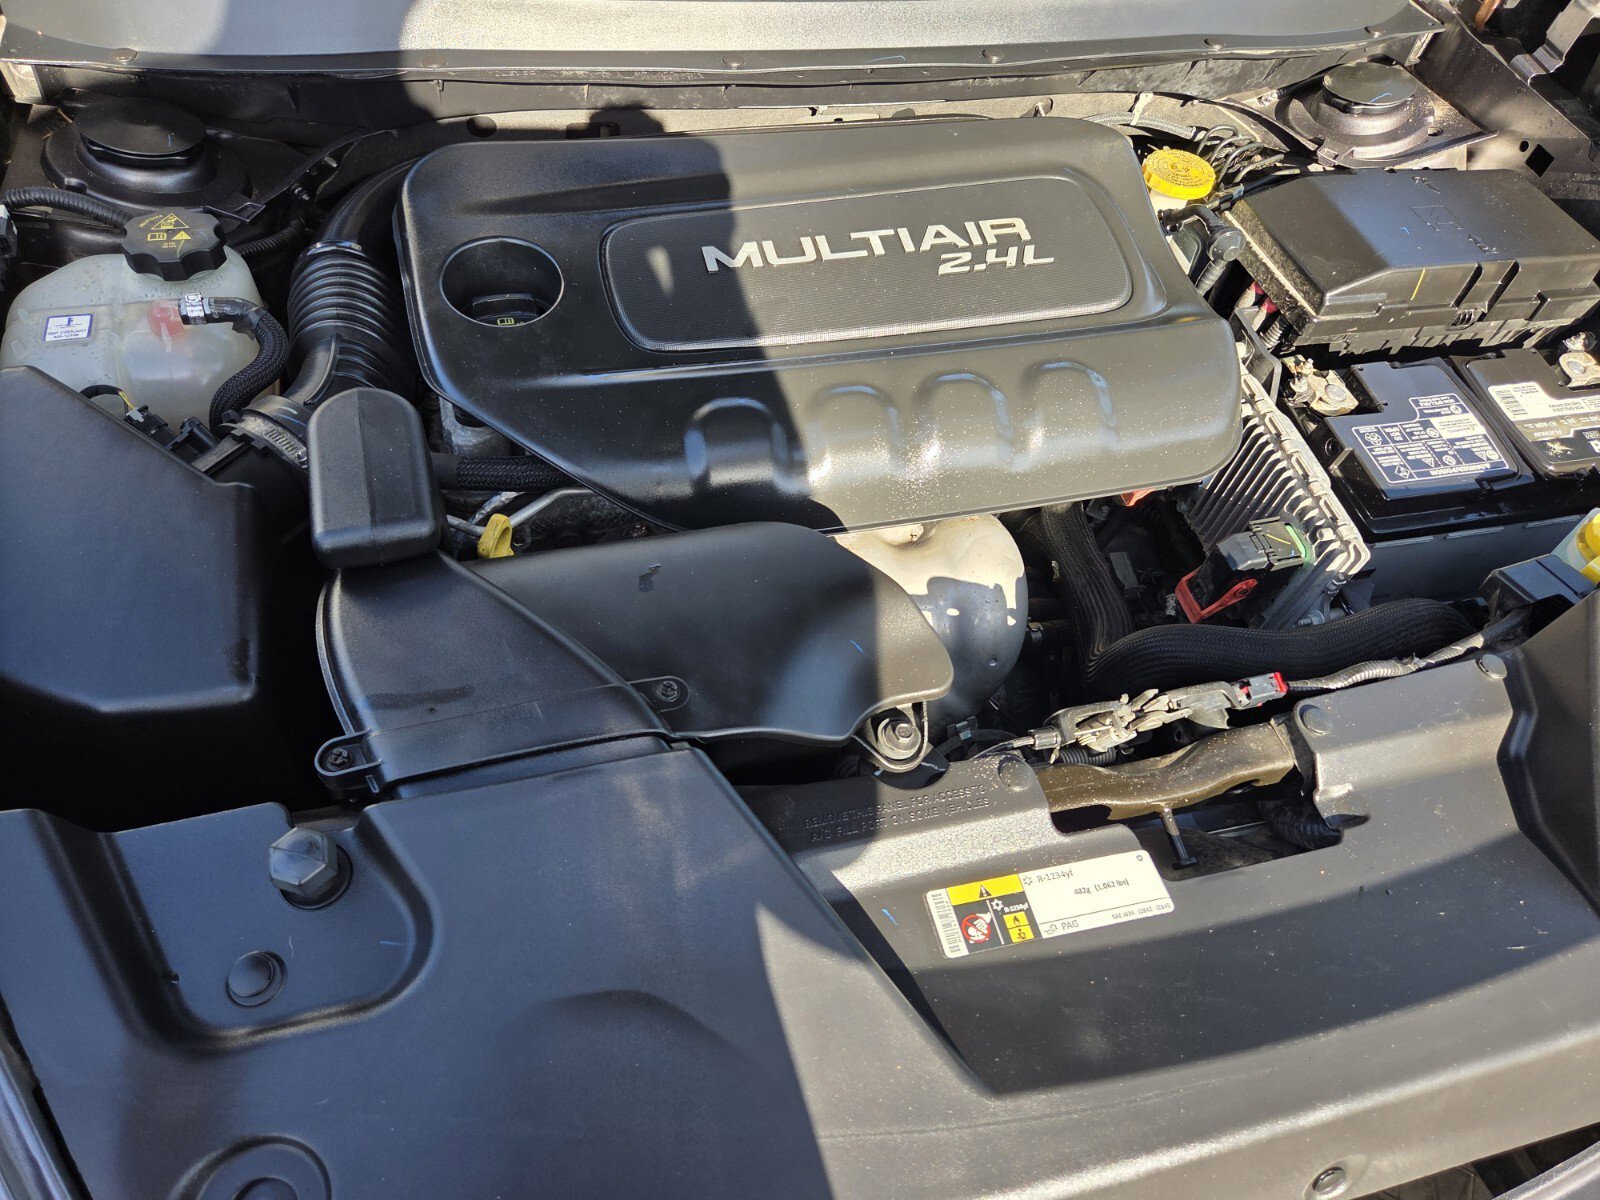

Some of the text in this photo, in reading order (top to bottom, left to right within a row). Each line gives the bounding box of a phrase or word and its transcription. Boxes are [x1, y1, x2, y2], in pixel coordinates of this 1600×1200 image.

[701, 217, 1031, 273] MULTIAIR
[937, 245, 1054, 275] 2.4L
[876, 799, 909, 815] PANEL
[910, 793, 931, 808] FOR
[933, 785, 971, 804] ACCESS
[972, 783, 986, 796] TO
[837, 822, 859, 837] FILL
[861, 817, 888, 832] PORT
[891, 811, 909, 825] ON
[909, 805, 940, 822] SOME
[944, 796, 990, 817] VEHICLES
[1037, 869, 1073, 884] R-1234yf
[1094, 879, 1116, 893] (1.062
[1116, 877, 1130, 888] lbs)
[1061, 919, 1079, 931] PAG
